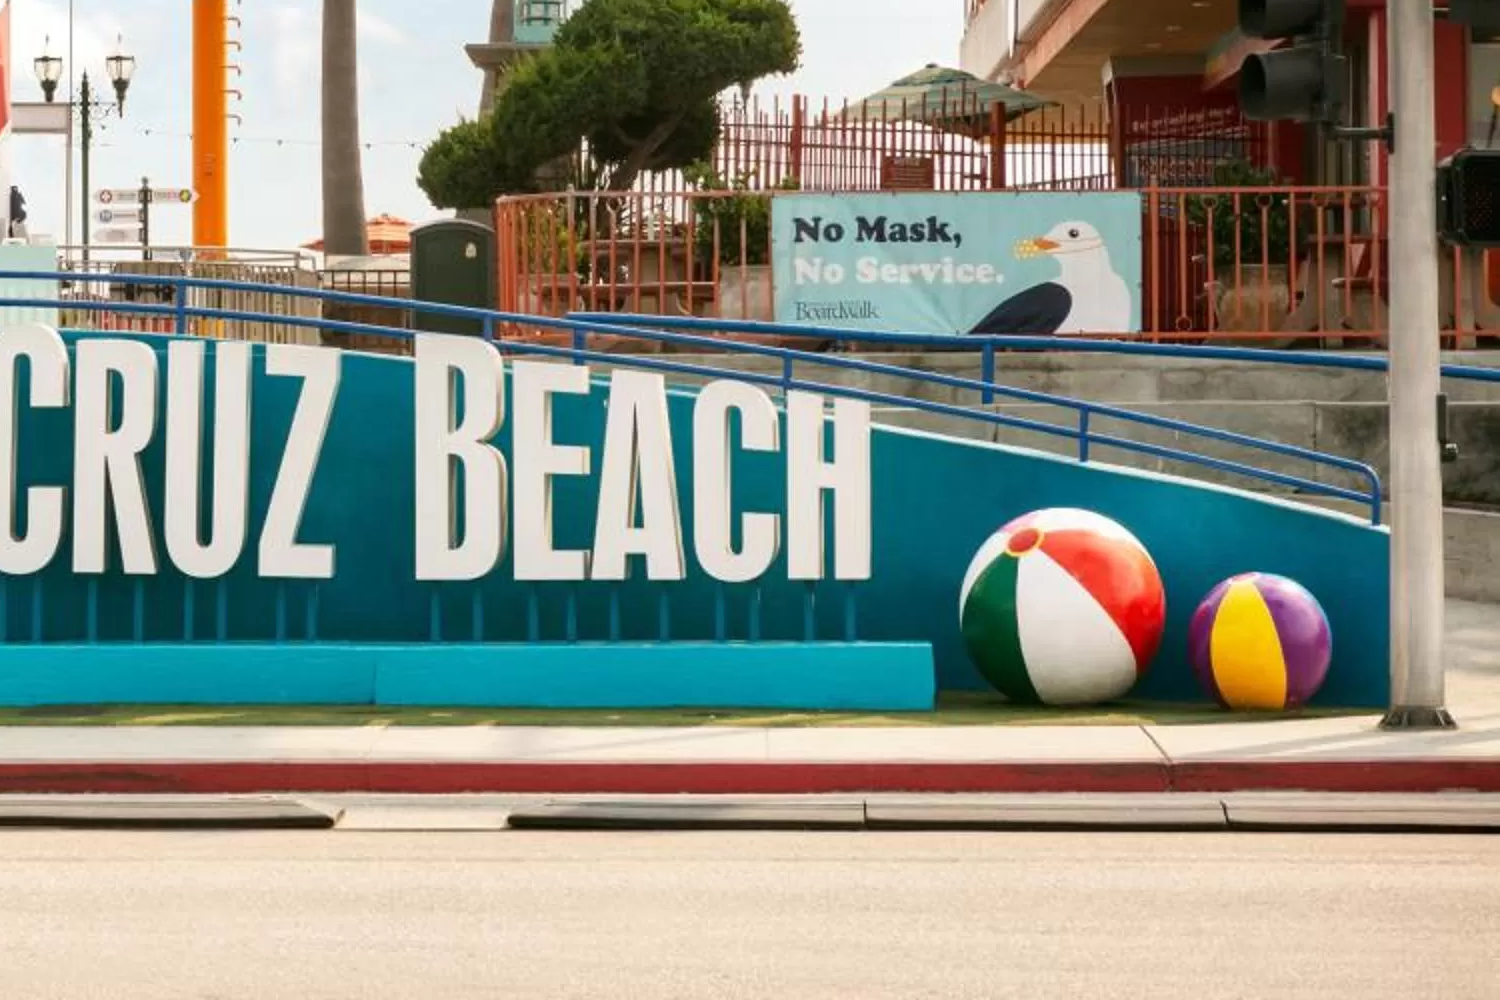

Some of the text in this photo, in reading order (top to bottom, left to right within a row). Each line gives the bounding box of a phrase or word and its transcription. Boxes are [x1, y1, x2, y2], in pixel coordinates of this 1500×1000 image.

[793, 215, 963, 250] No Mask,
[793, 256, 1005, 286] No Service.
[413, 334, 874, 583] BEACH
